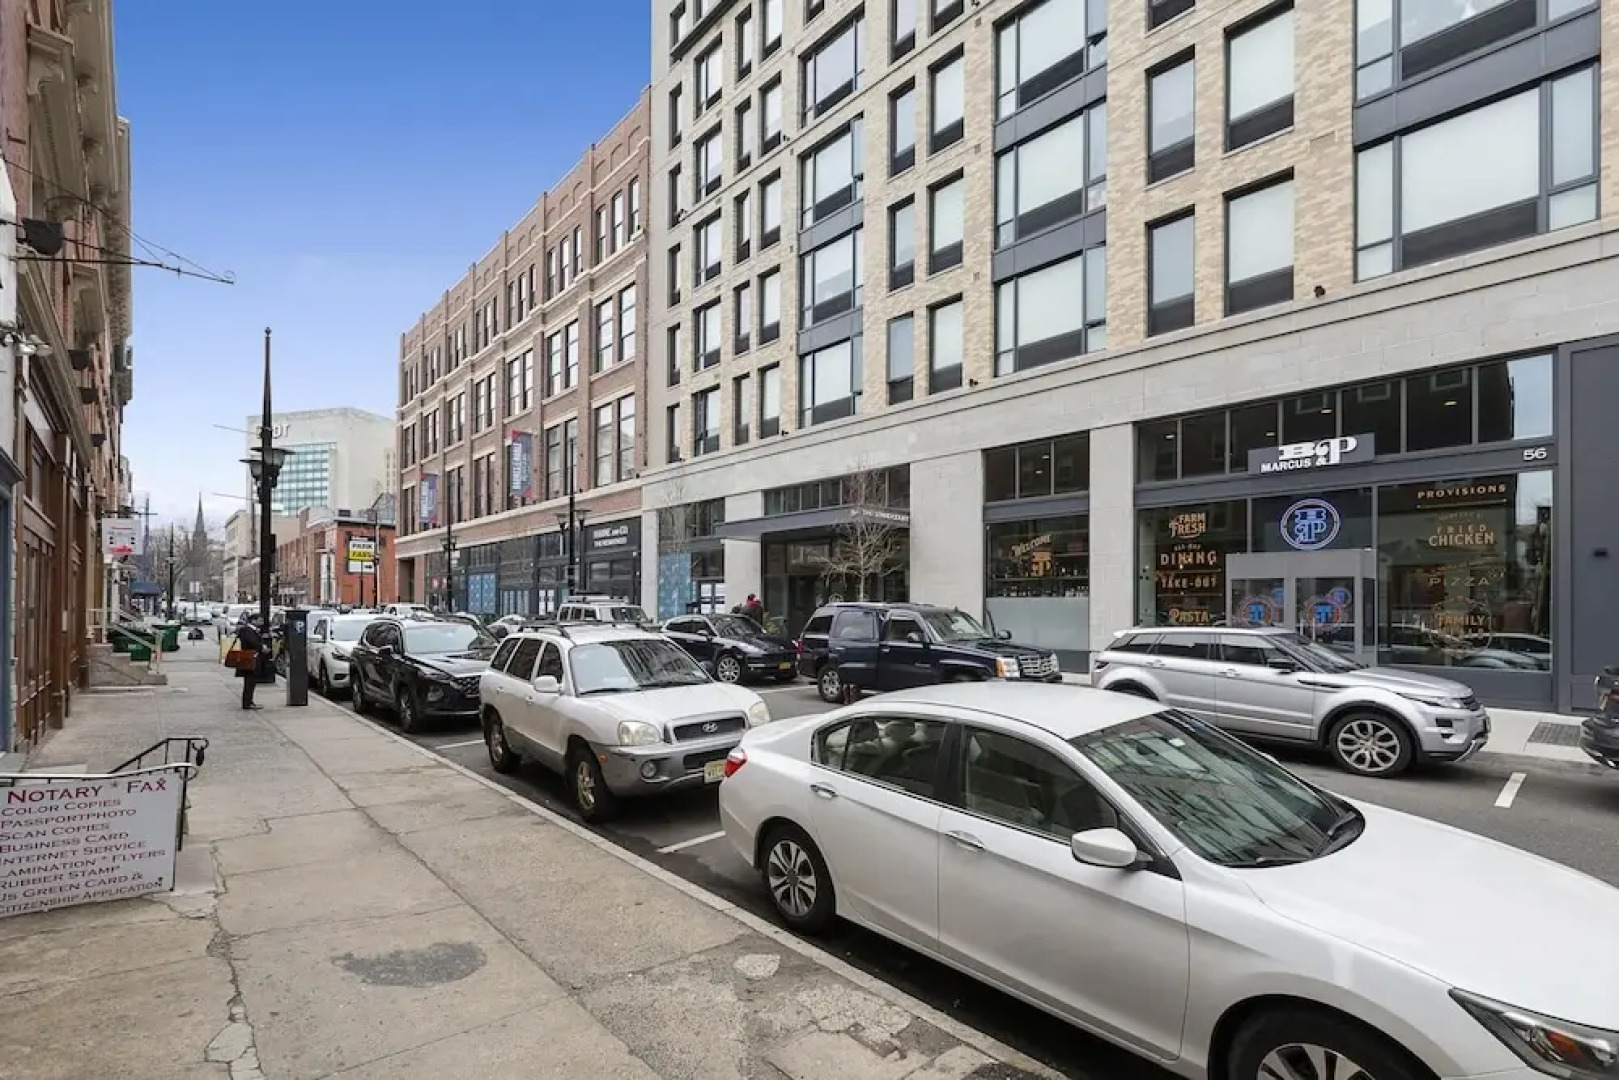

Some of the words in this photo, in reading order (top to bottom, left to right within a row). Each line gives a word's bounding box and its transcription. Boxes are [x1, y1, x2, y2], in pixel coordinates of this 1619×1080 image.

[1523, 447, 1547, 461] 56
[1260, 457, 1311, 473] MARCUS
[1417, 484, 1507, 499] PROVISIONS
[1179, 513, 1206, 524] FARM
[1169, 522, 1206, 538] FRESH
[1437, 523, 1488, 535] FRIED
[1428, 532, 1495, 547] CHICKEN
[1160, 550, 1217, 566] DINING
[7, 785, 103, 804] NOTARY
[126, 778, 168, 794] FAX
[1, 803, 60, 817] COLOR
[64, 798, 122, 811] COPIES
[0, 808, 138, 829] PASSPORTPHOTO
[0, 829, 47, 842] SCAN
[51, 822, 110, 835] COPIES
[0, 837, 82, 854] BUSINESS
[85, 831, 129, 843] CARD
[83, 840, 148, 855] SERVICE
[112, 849, 166, 863] FLYERS
[68, 865, 121, 880] STAMP
[22, 883, 80, 897] GREEN
[85, 875, 129, 888] CARD
[131, 871, 143, 882] &
[82, 879, 163, 901] APPLICATION
